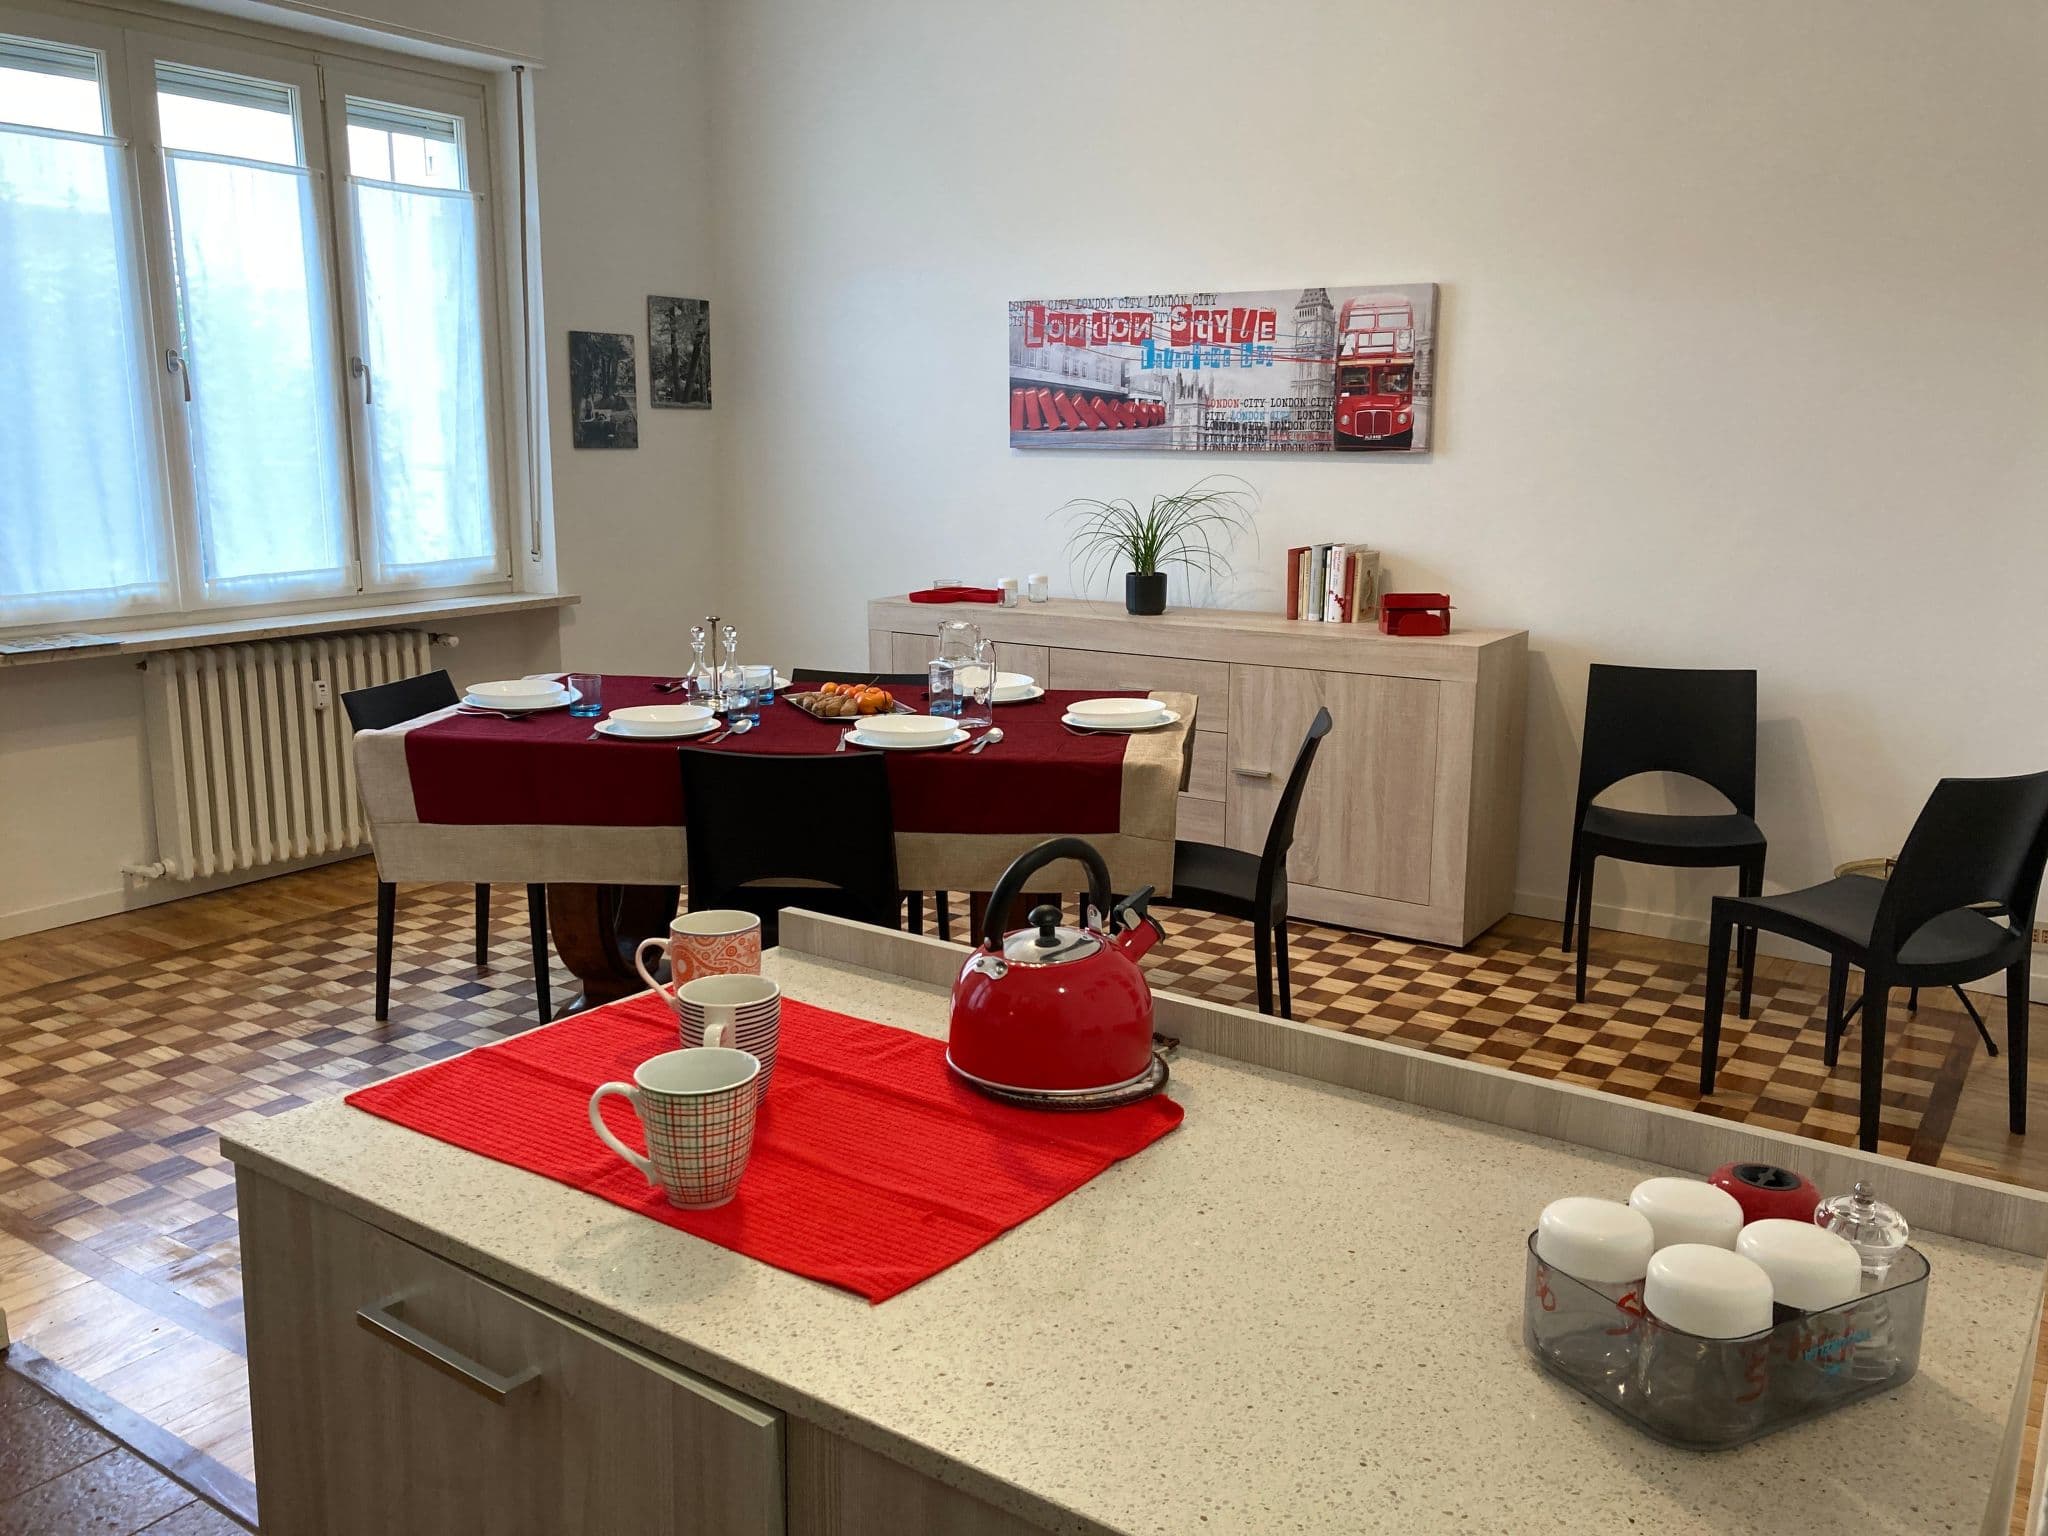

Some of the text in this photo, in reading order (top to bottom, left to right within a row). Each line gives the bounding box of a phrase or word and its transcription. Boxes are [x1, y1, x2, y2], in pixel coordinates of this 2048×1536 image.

[1048, 299, 1072, 310] CITY
[1077, 298, 1115, 310] LONDON
[1119, 296, 1144, 309] CITY
[1148, 294, 1189, 308] LONDON
[1192, 293, 1219, 306] CITY
[1206, 399, 1240, 408] LONDON
[1270, 398, 1306, 408] LONDON
[1310, 397, 1335, 407] CITY
[1204, 411, 1227, 420] CITY
[1230, 411, 1265, 420] LONDON
[1297, 410, 1333, 420] LONDON
[1269, 421, 1306, 431] LONDON
[1310, 421, 1333, 430] CITY
